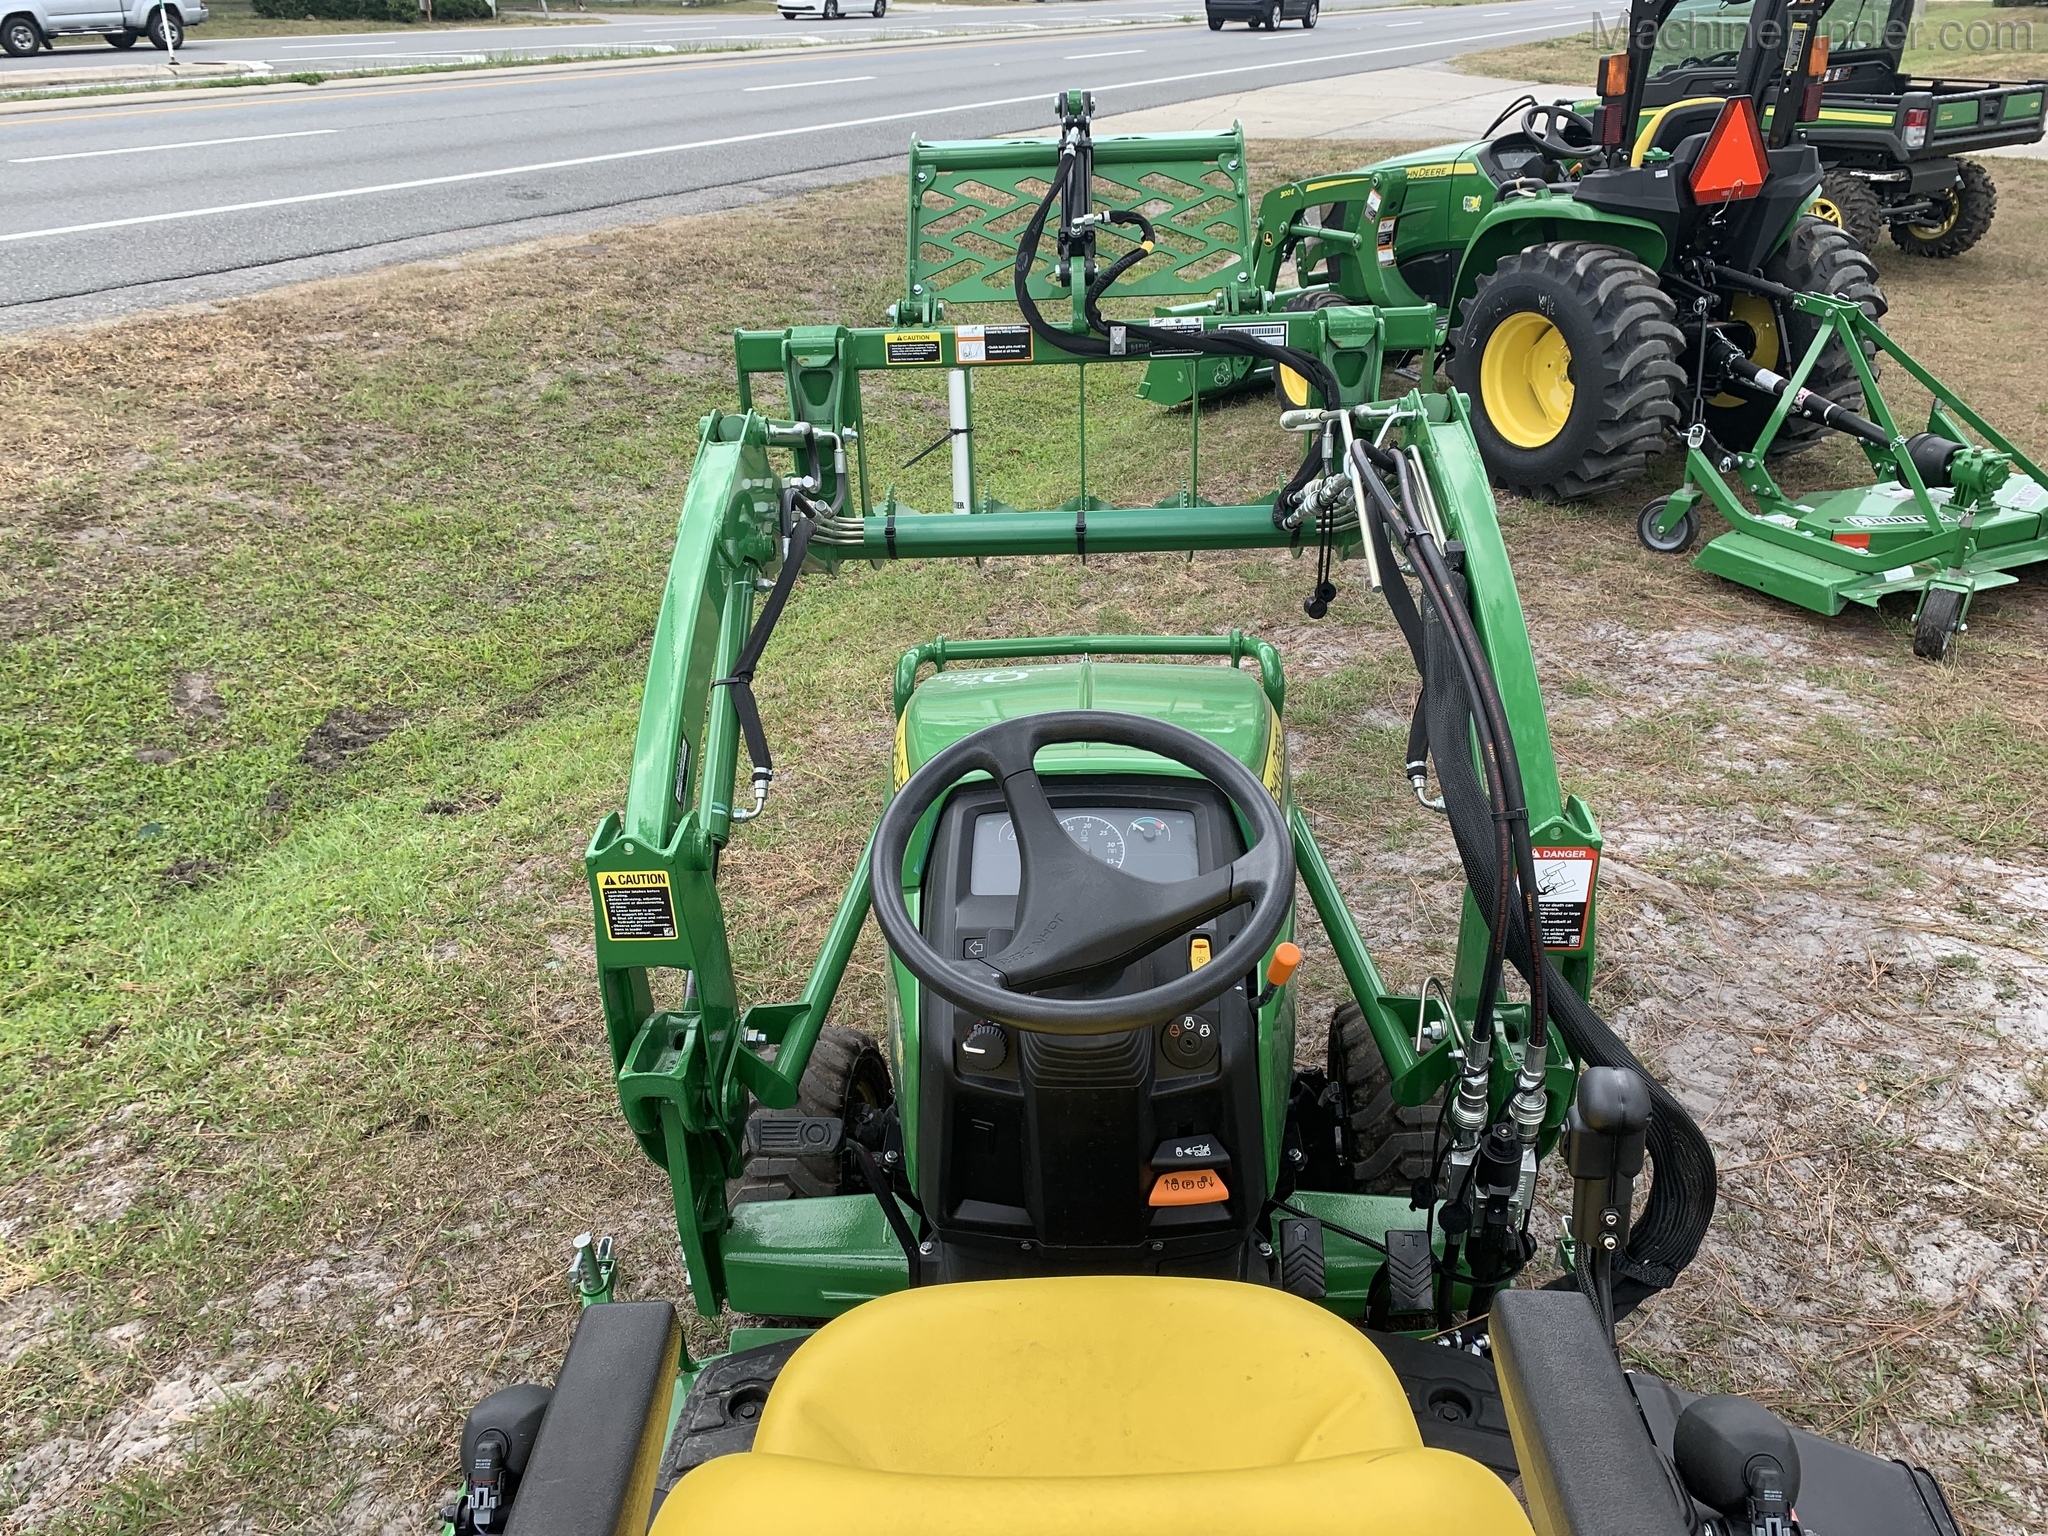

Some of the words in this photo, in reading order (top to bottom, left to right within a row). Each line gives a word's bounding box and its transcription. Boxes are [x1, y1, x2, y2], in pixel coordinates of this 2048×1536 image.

[1406, 169, 1420, 178] HN
[1419, 167, 1447, 177] DEERE
[1543, 850, 1586, 858] DANGER
[618, 874, 666, 885] CAUTION
